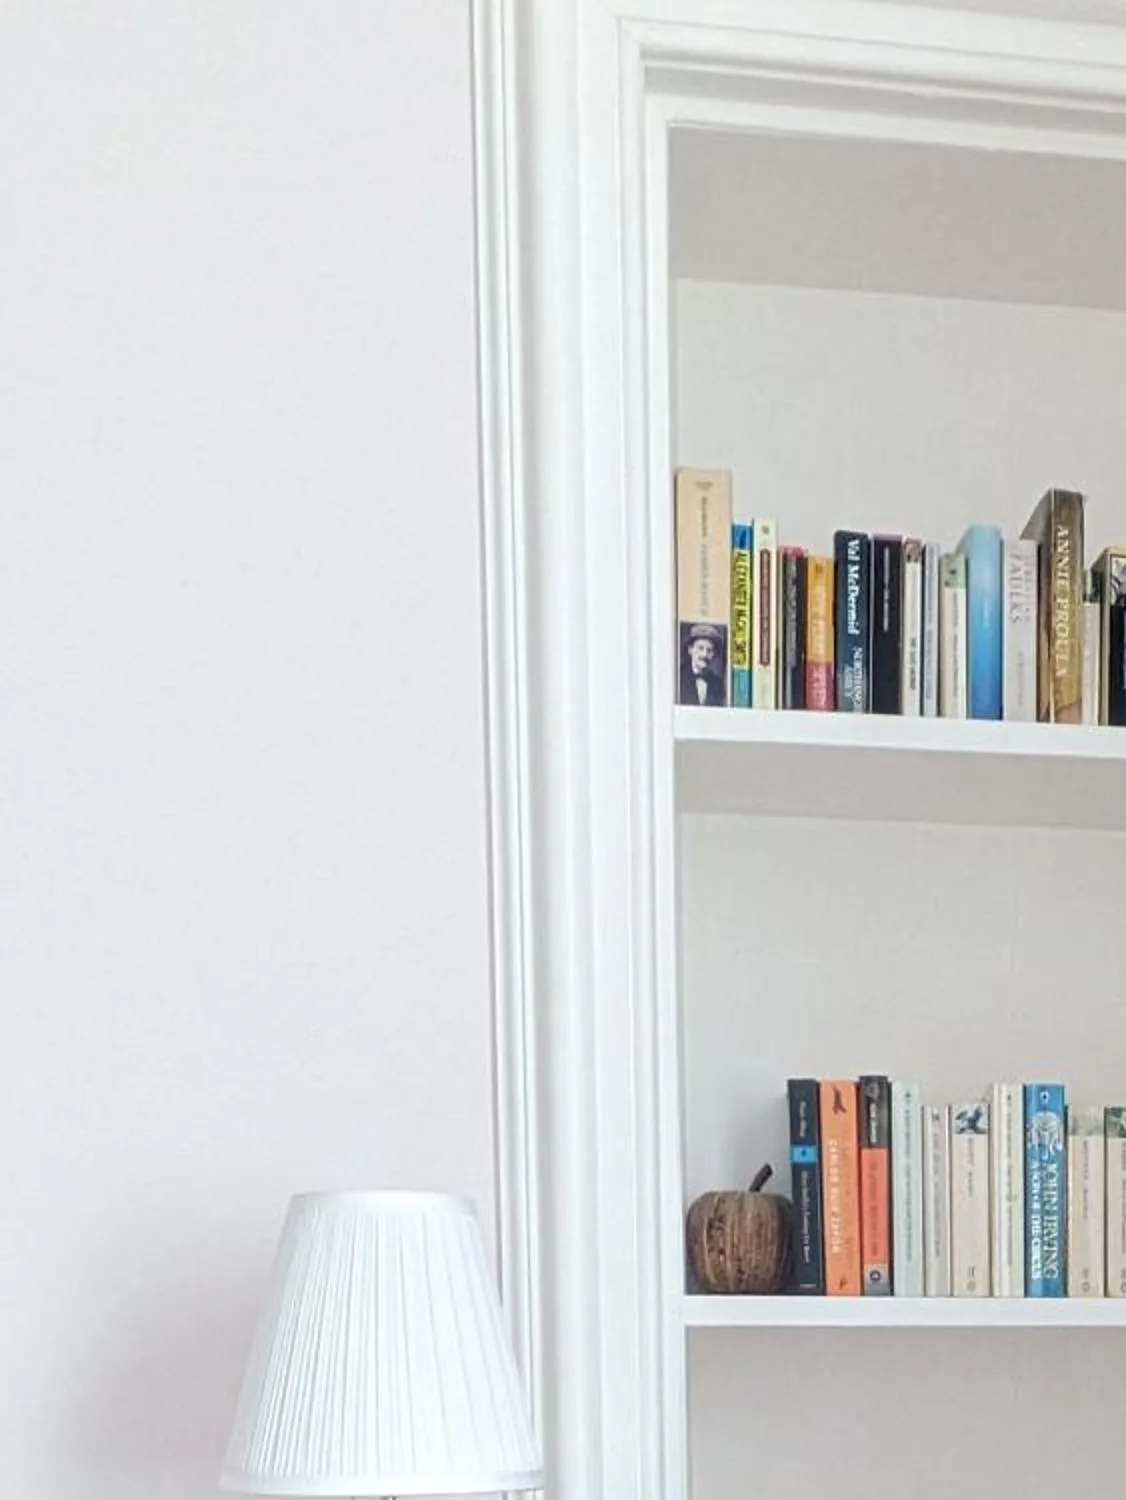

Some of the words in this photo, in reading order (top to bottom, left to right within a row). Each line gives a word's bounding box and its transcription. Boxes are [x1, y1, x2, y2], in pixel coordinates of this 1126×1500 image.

[847, 540, 861, 560] Val
[1055, 525, 1071, 588] ANNIE
[846, 563, 861, 635] McDermid
[1008, 551, 1023, 625] FAULKS
[1042, 1161, 1059, 1211] JOHN
[1042, 1215, 1059, 1279] IRVING
